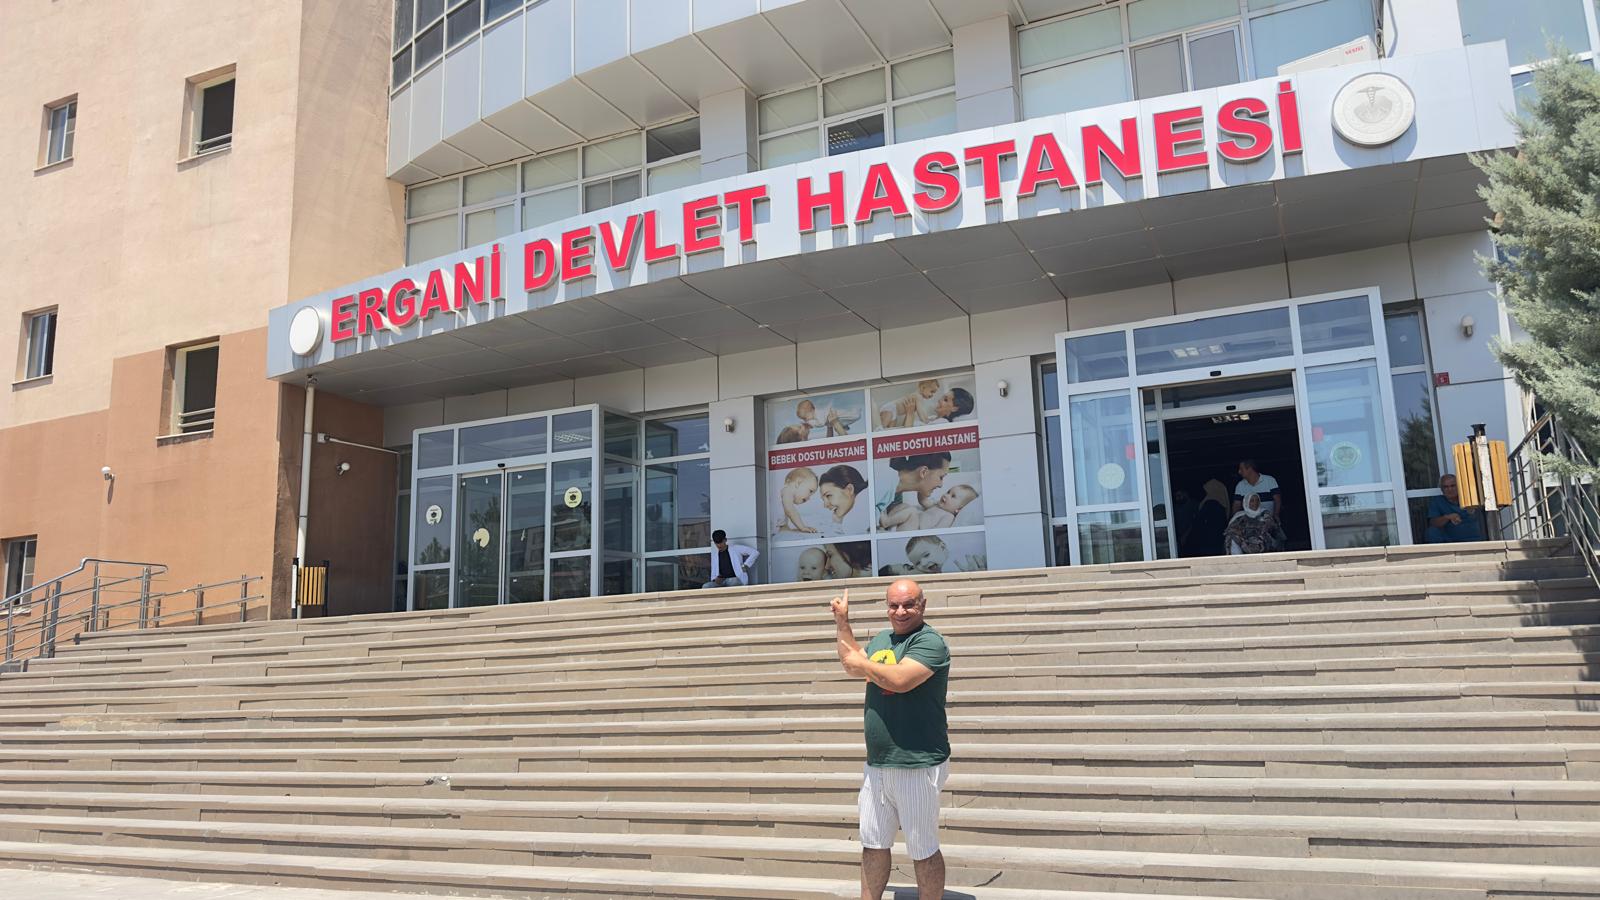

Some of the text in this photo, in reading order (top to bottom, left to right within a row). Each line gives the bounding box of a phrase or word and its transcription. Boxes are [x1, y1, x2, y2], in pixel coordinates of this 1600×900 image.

[331, 80, 1303, 343] ERGANİ DEVLET HASTANESİ
[877, 432, 976, 453] ANNE DOSTU HASTANE
[770, 445, 865, 465] BEBEK DOSTU HASTANE
